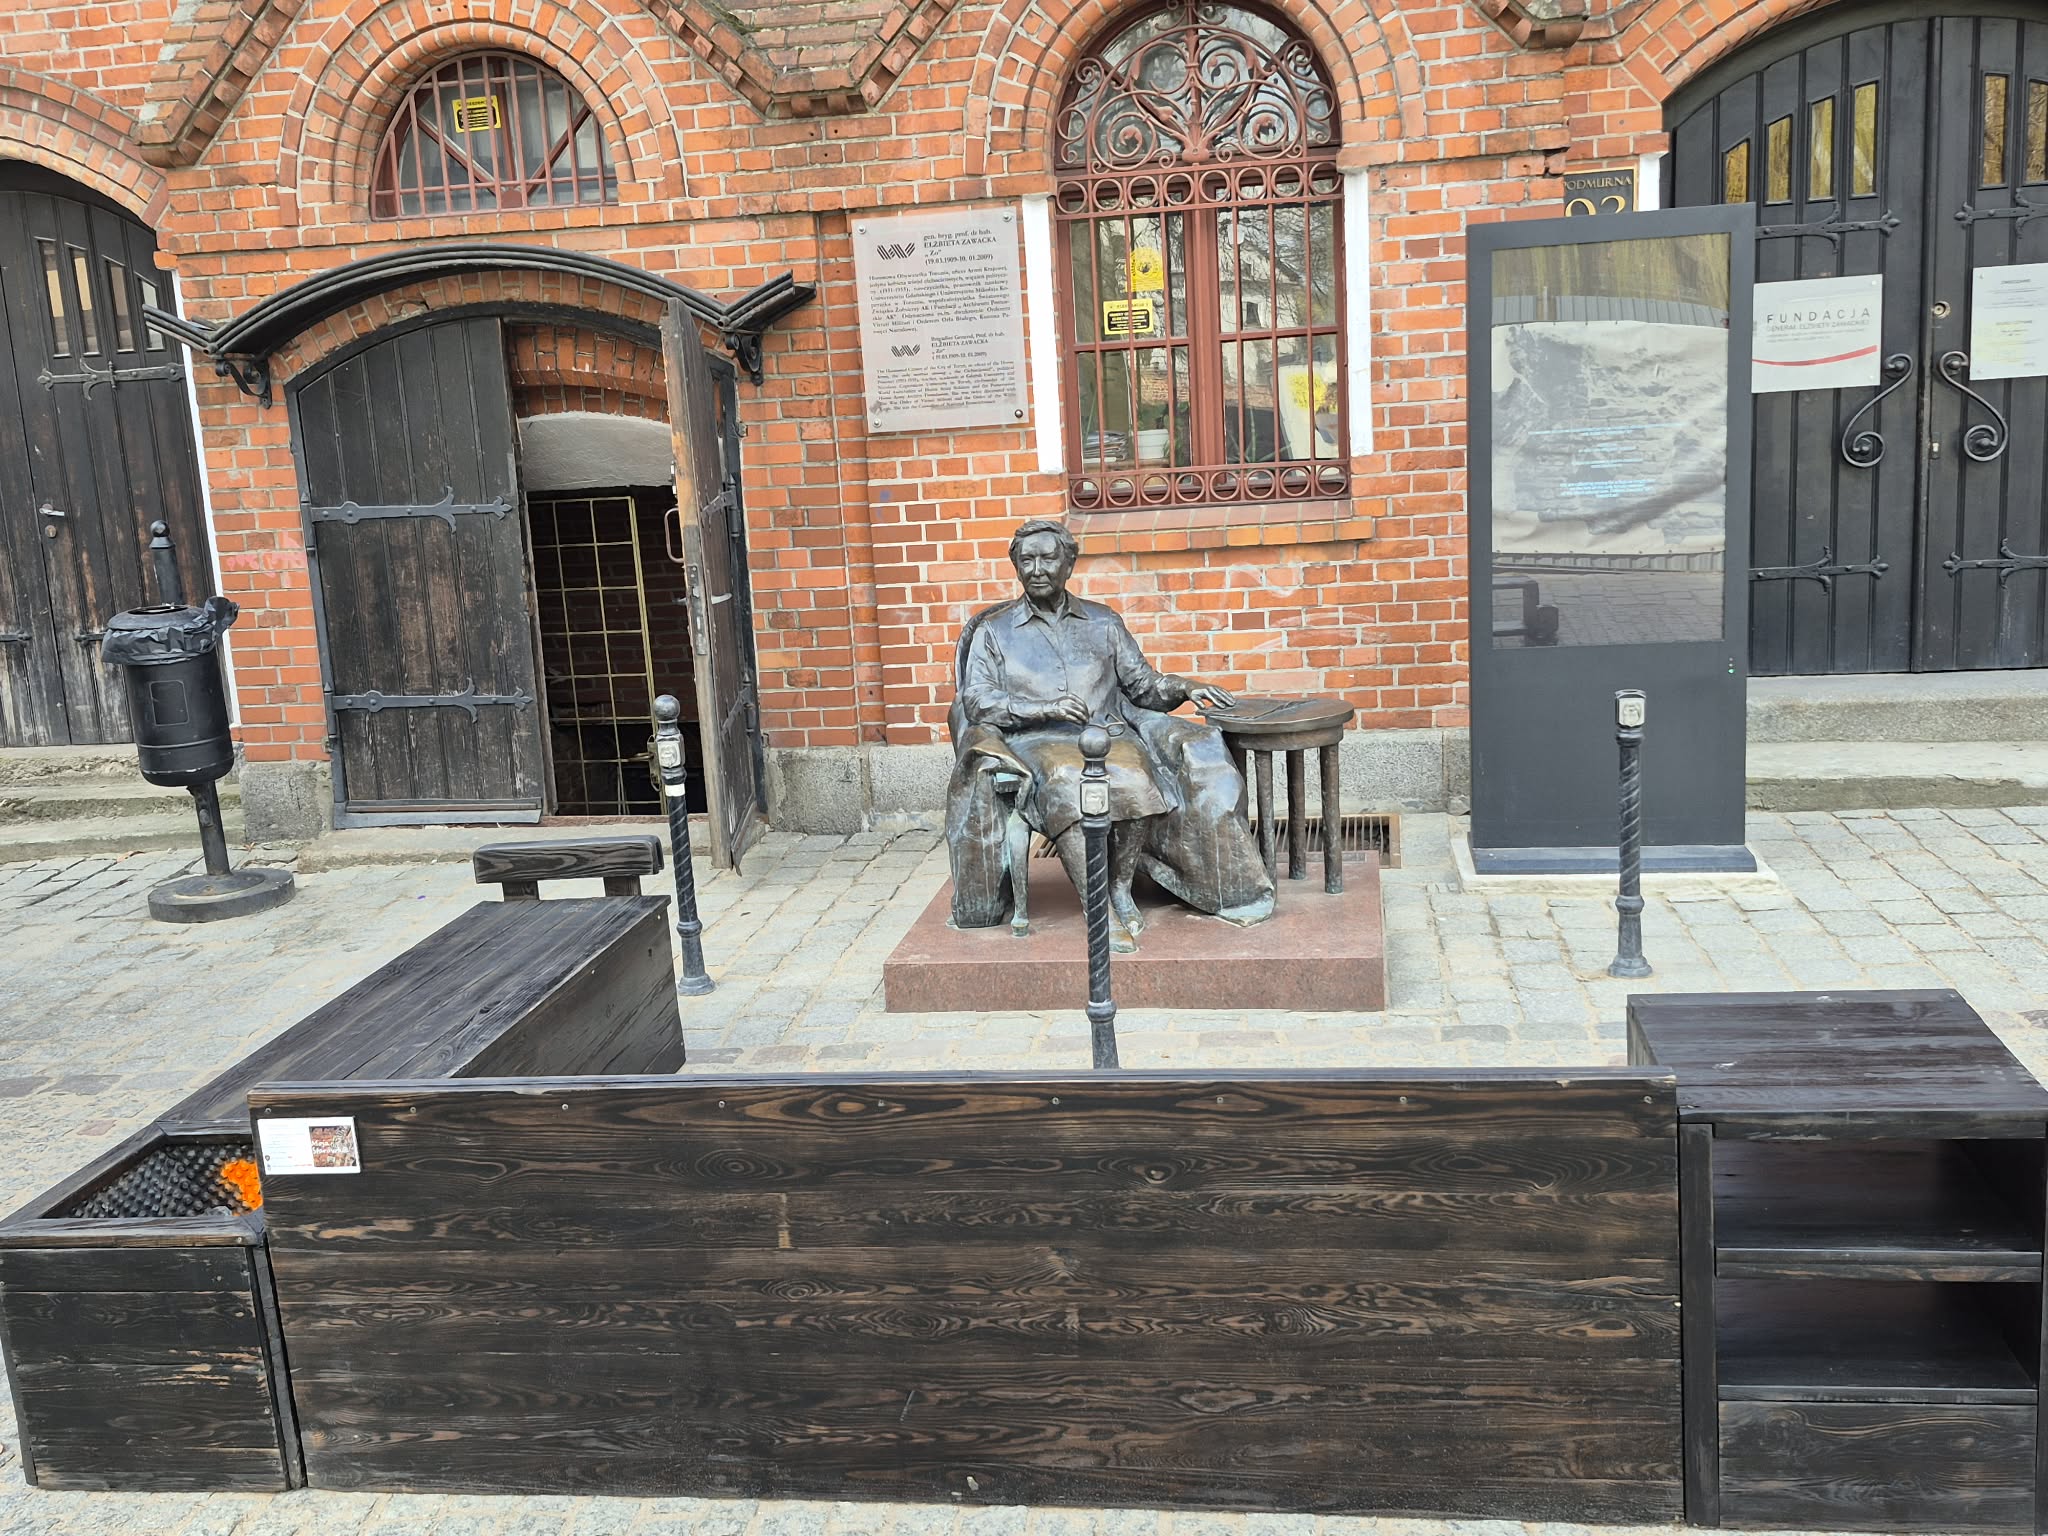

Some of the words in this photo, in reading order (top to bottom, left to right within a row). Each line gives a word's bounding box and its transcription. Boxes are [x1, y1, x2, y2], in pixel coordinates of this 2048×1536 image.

[924, 239, 960, 248] ELŻBIETA
[962, 236, 997, 245] ZAWACKA
[1767, 307, 1870, 323] FUNDACJA
